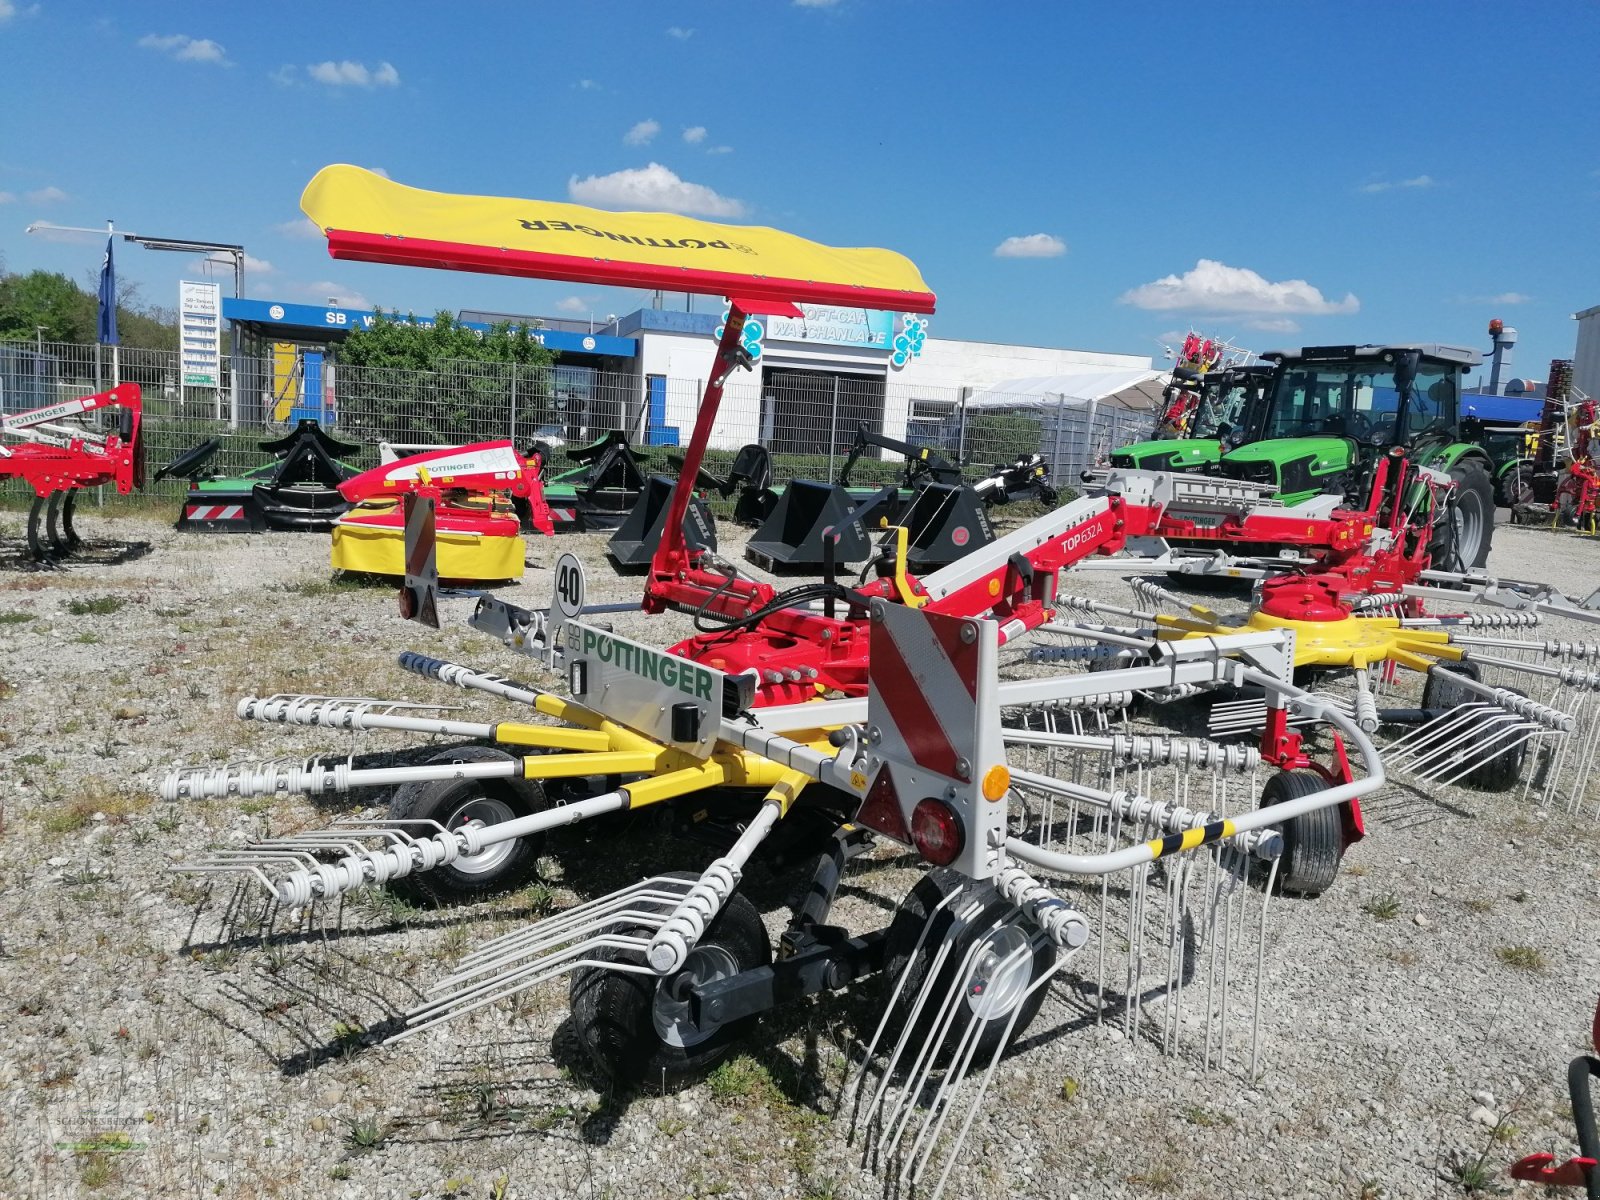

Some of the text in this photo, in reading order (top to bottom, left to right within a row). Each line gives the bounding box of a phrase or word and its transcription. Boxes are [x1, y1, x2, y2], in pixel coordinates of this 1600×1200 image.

[325, 312, 347, 325] SB
[773, 321, 886, 344] WASCHANLAGE
[803, 306, 867, 326] OFT-CAR
[688, 503, 711, 540] STOLL
[847, 506, 865, 541] SOLL
[975, 507, 992, 541] STOLL
[1061, 521, 1103, 554] TOP 632A
[558, 565, 580, 607] 40
[583, 628, 713, 702] PÖTTINGER
